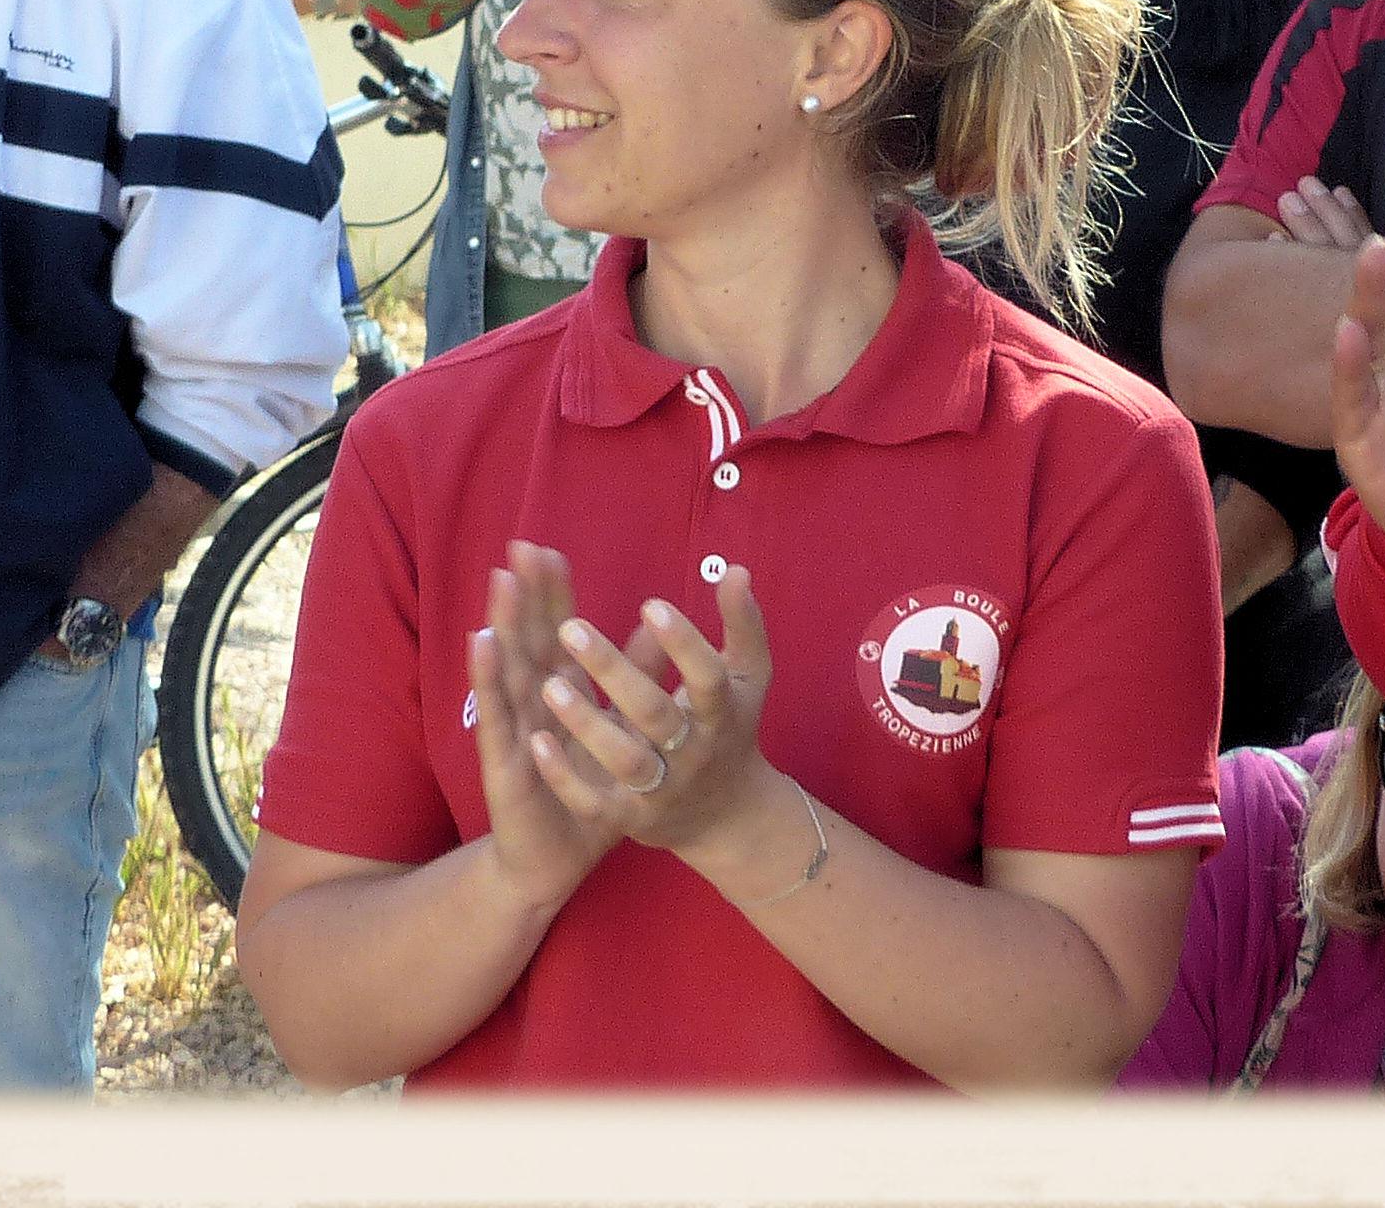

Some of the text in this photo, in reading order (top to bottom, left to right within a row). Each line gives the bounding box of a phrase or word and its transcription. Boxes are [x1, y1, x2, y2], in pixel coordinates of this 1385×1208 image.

[893, 590, 1010, 635] LA BOULE
[872, 695, 981, 754] TROPEZIENNE
